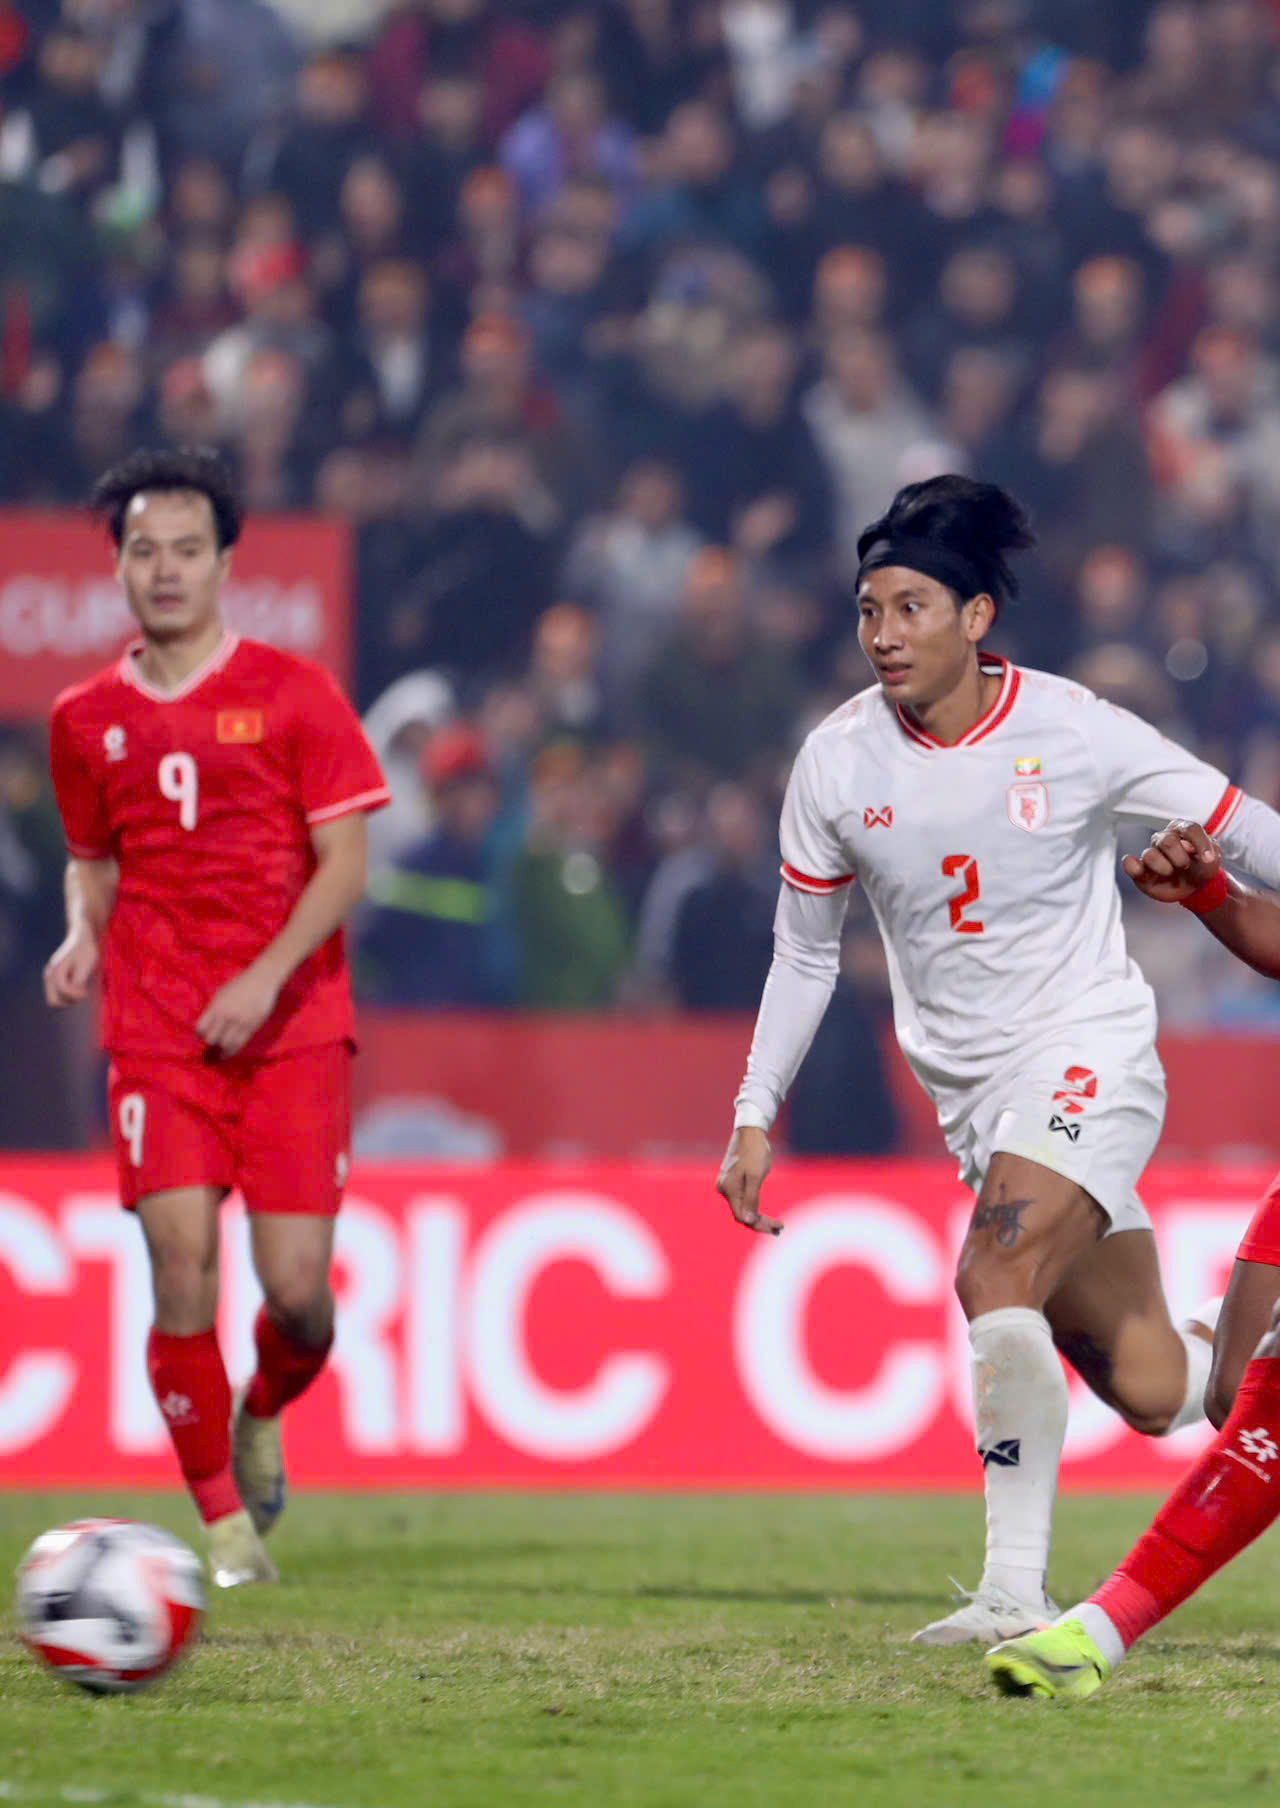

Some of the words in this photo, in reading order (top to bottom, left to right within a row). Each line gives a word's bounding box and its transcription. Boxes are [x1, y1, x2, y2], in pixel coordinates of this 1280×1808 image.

[158, 751, 198, 832] 9
[941, 854, 984, 934] 2
[118, 1092, 146, 1168] 9
